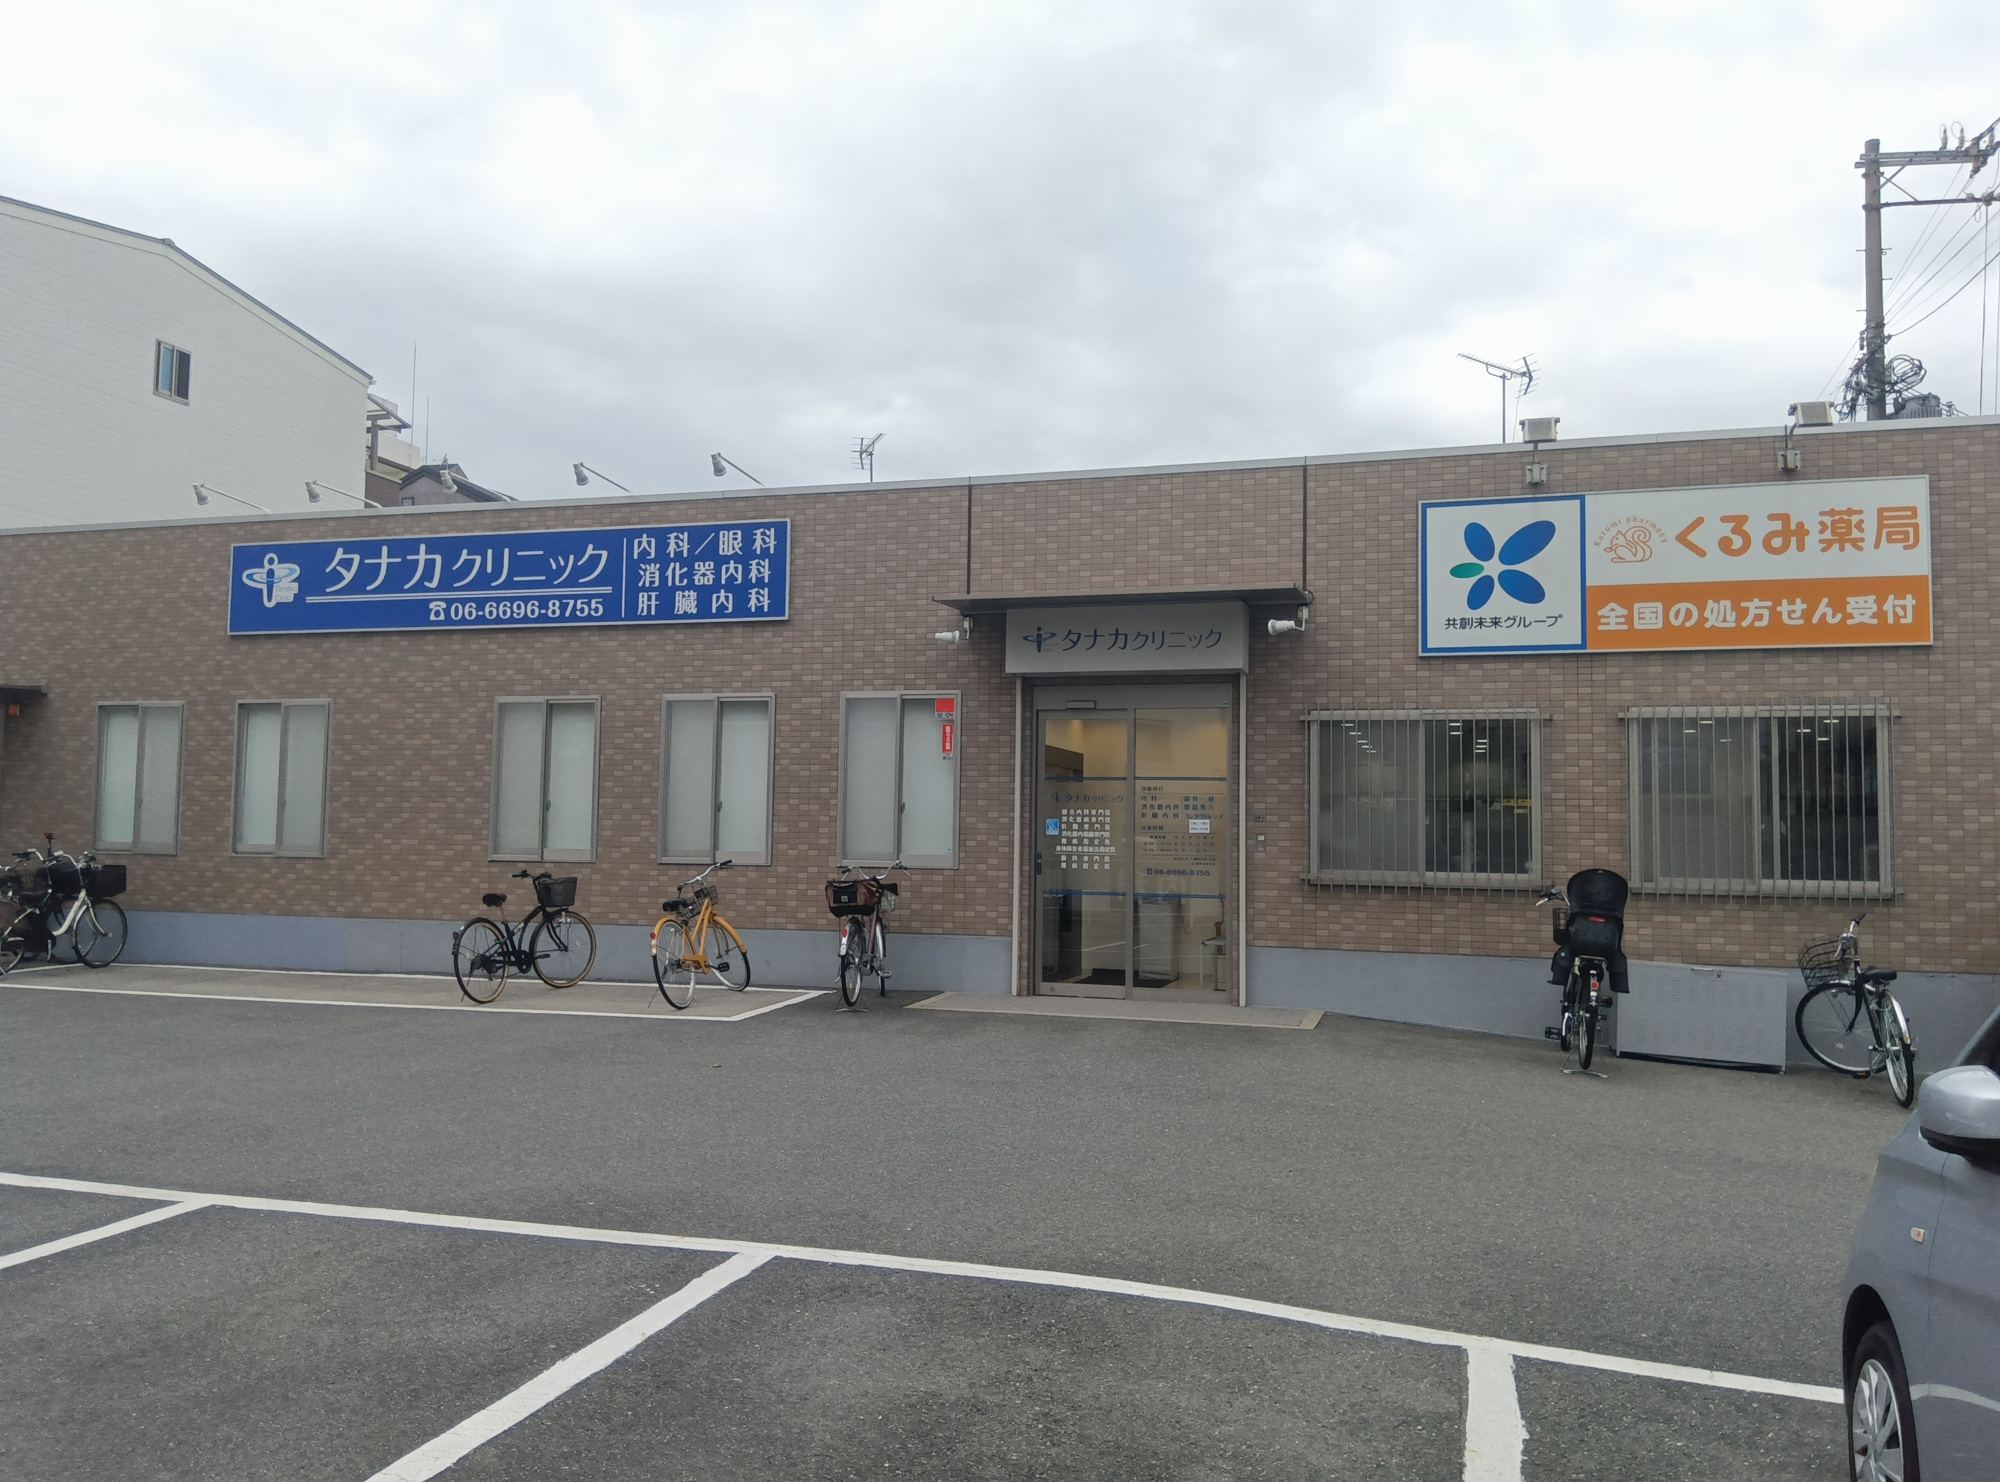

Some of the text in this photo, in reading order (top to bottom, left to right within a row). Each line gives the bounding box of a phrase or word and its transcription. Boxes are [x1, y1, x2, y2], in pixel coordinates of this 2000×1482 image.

[1593, 515, 1669, 547] Kurumi pharmacy
[1674, 505, 1922, 558] くるみ薬局
[324, 543, 609, 594] タナカクリニック
[638, 560, 772, 588] 消化器内科
[450, 600, 605, 622] 06-6696-8755
[636, 587, 772, 616] 肝臓内科
[1596, 593, 1917, 631] 全国の処方せん受付
[1443, 613, 1564, 631] 共創未来グループ
[1061, 627, 1223, 652] タナカクリニック
[1065, 793, 1124, 803] タナカクリニック
